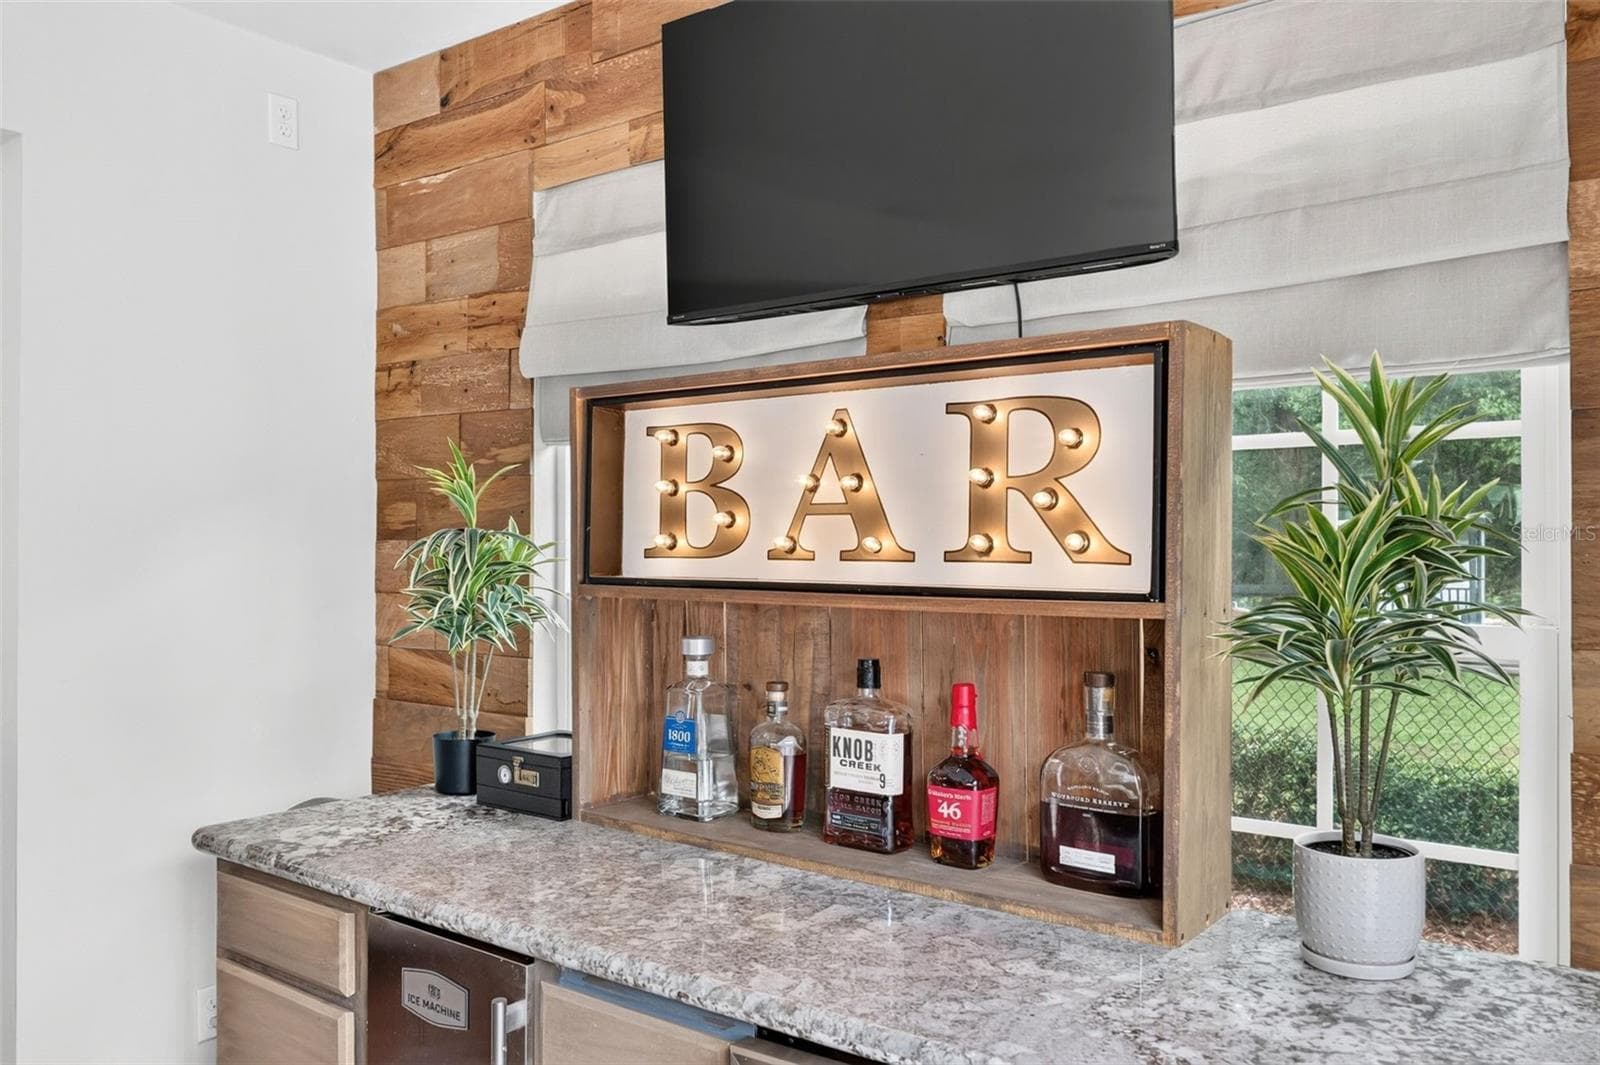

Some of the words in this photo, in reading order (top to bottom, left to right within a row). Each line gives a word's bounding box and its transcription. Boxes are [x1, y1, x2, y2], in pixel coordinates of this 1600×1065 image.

[644, 395, 1132, 565] BAR
[668, 728, 691, 743] 1800
[832, 735, 873, 762] KNOB
[839, 758, 882, 772] CREEK
[879, 773, 886, 789] 9
[937, 800, 962, 820] 46
[408, 993, 420, 1006] ICE
[422, 999, 461, 1021] MACHINE
